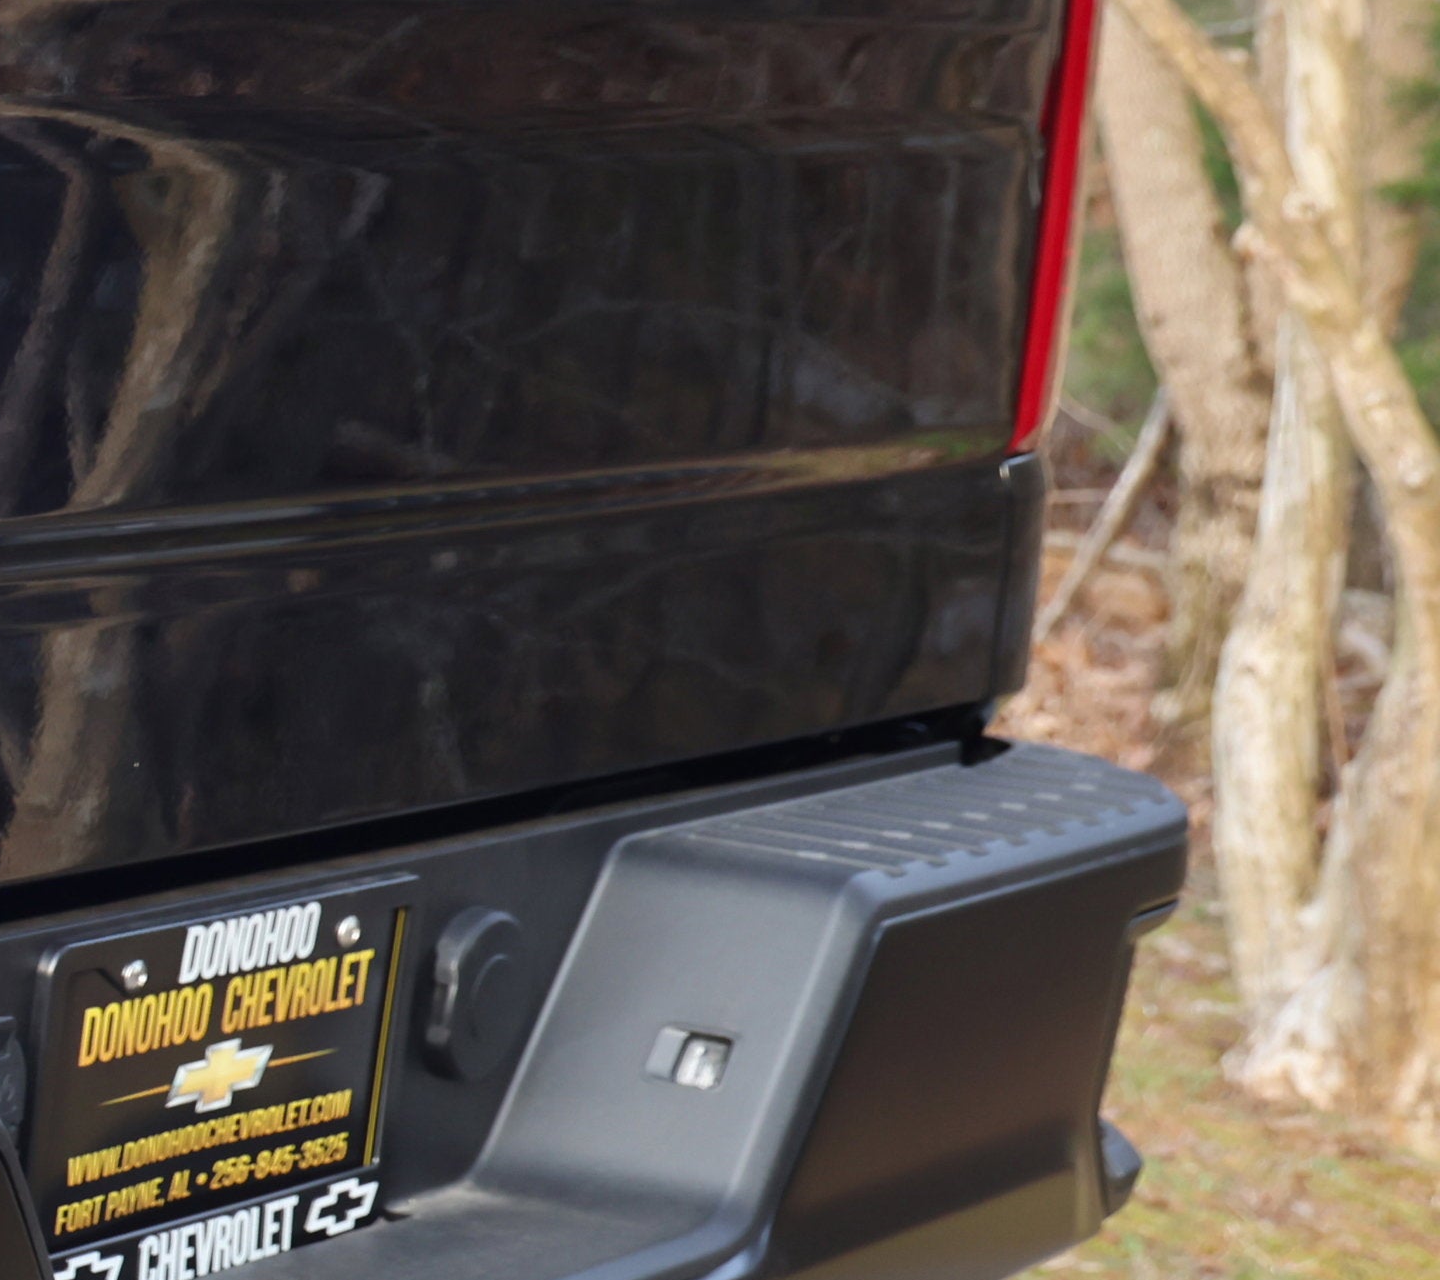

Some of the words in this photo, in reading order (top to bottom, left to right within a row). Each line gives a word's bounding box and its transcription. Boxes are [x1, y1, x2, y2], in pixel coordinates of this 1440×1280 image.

[178, 902, 322, 985] DONOHOO
[78, 983, 214, 1067] DONOHOO
[221, 949, 375, 1036] CHEVROLET
[55, 1196, 105, 1235] FORT
[104, 1178, 165, 1221] PAYNE,
[167, 1172, 191, 1200] AL
[209, 1131, 350, 1190] 256-845-3525
[67, 1089, 352, 1187] WWW.DONOHOOCHEVROLET.COM
